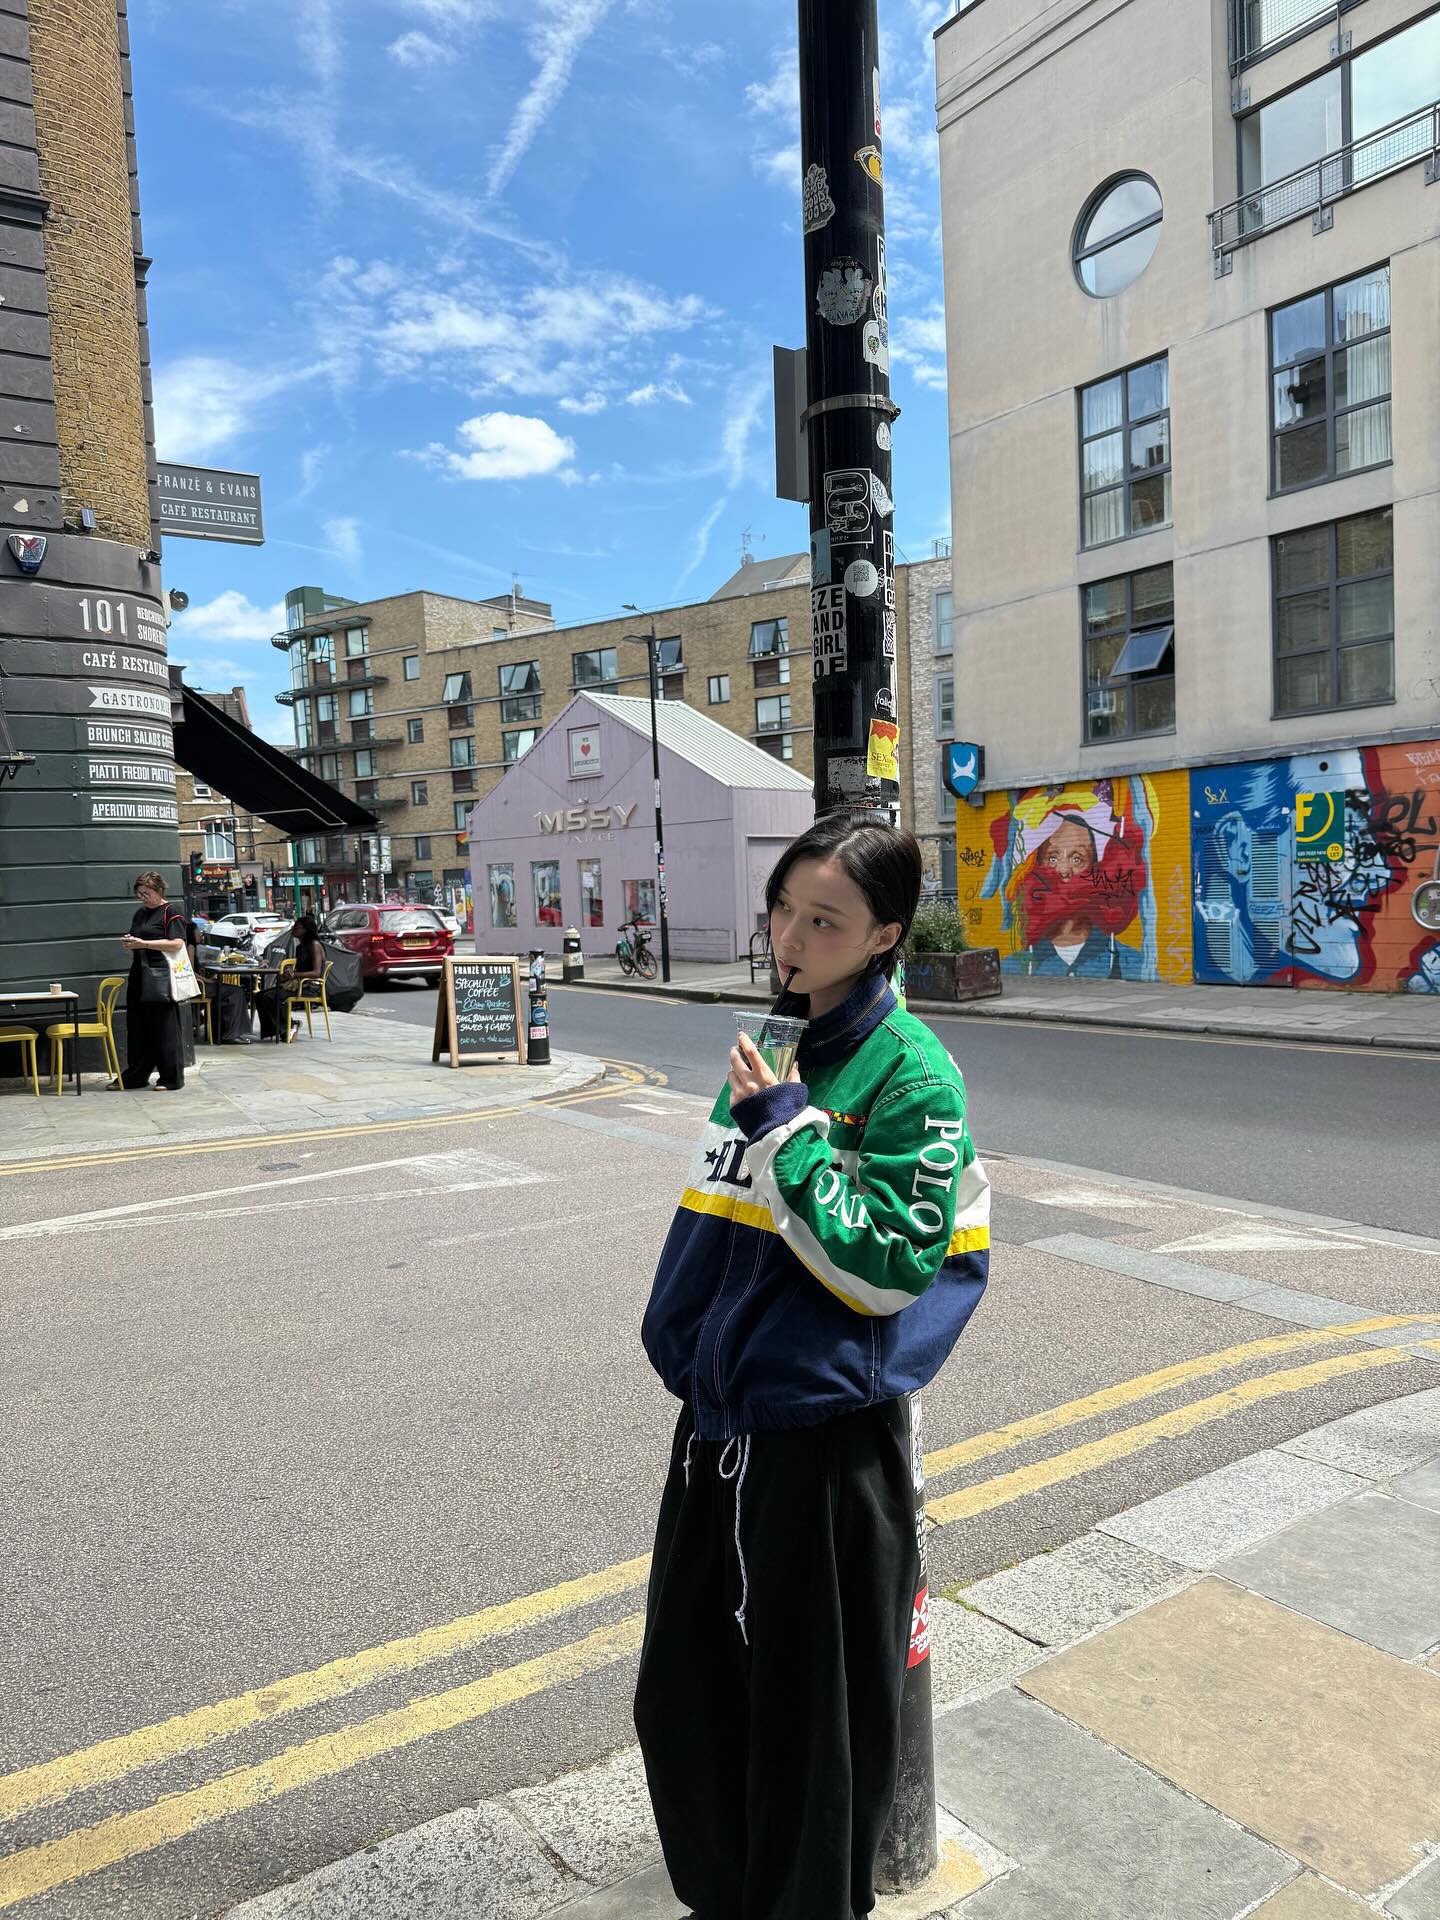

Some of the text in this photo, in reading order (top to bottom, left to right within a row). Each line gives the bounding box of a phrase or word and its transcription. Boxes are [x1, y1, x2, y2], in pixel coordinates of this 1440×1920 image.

[206, 481, 213, 493] &
[220, 482, 256, 498] EVANS
[161, 503, 256, 525] CAFÉ RESTAURANT
[79, 598, 126, 634] 101
[813, 610, 844, 636] AND
[813, 633, 844, 658] GIRL
[82, 650, 168, 679] CAFÉ RESTAURA
[87, 726, 131, 743] BRUNCH
[134, 730, 161, 746] SALADS
[89, 764, 119, 779] PIATTI
[122, 765, 150, 781] FREDDI
[92, 803, 136, 817] APERITIVI
[137, 804, 159, 818] BIRRE
[482, 966, 487, 975] &
[490, 966, 512, 975] EVANS
[467, 988, 500, 998] COFFEE
[909, 1115, 963, 1234] POLO
